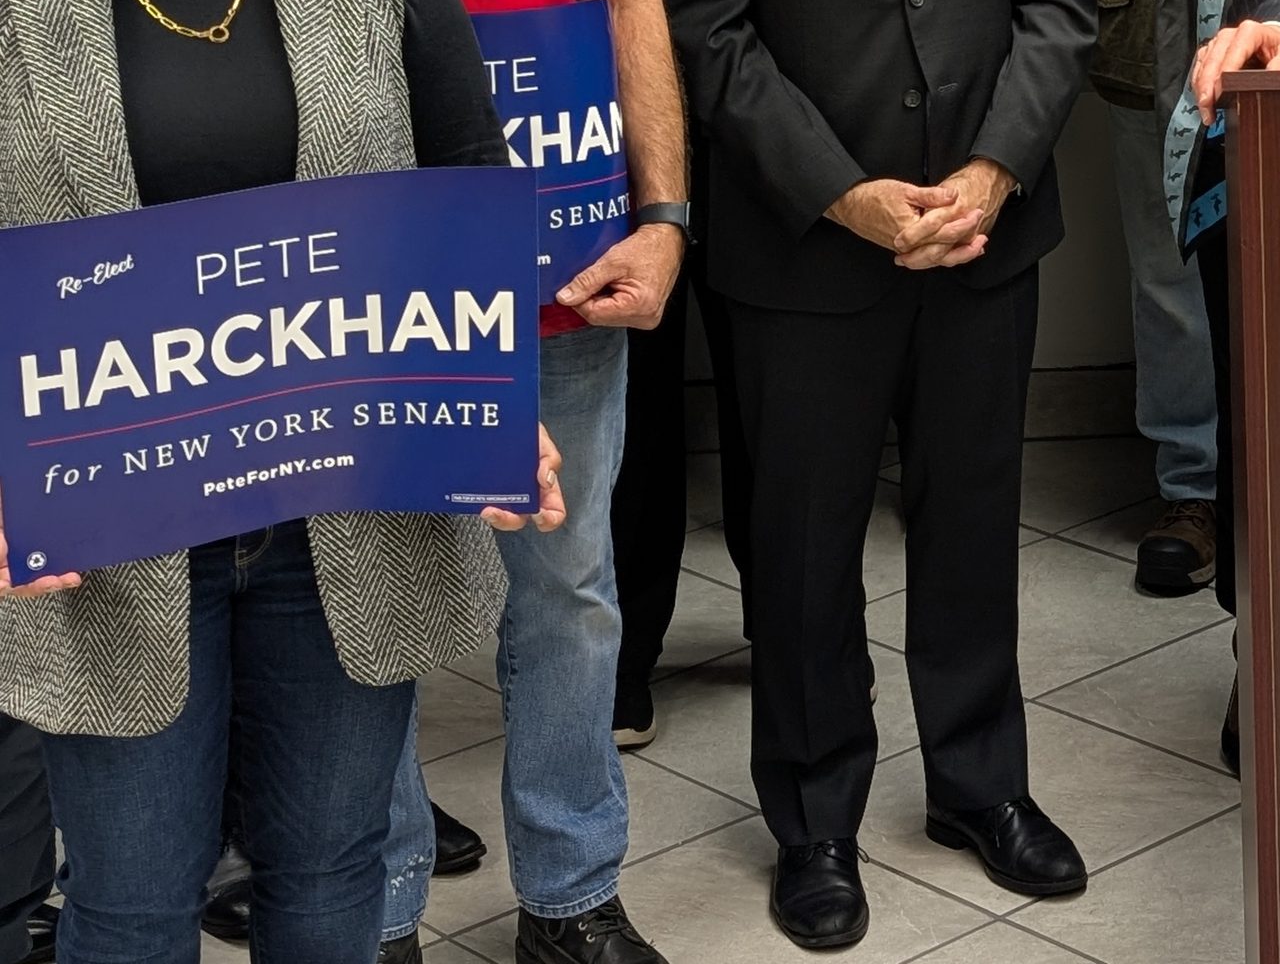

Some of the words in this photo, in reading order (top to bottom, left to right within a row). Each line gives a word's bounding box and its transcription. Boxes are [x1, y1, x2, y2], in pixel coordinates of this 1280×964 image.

[57, 254, 134, 298] Re-Elect
[197, 232, 339, 294] PETE
[20, 290, 515, 418] HARCKHAM
[46, 465, 101, 493] for
[123, 435, 210, 474] NEW
[230, 408, 333, 448] YORK
[354, 403, 498, 425] SENATE
[204, 456, 354, 496] PeteForNY.com
